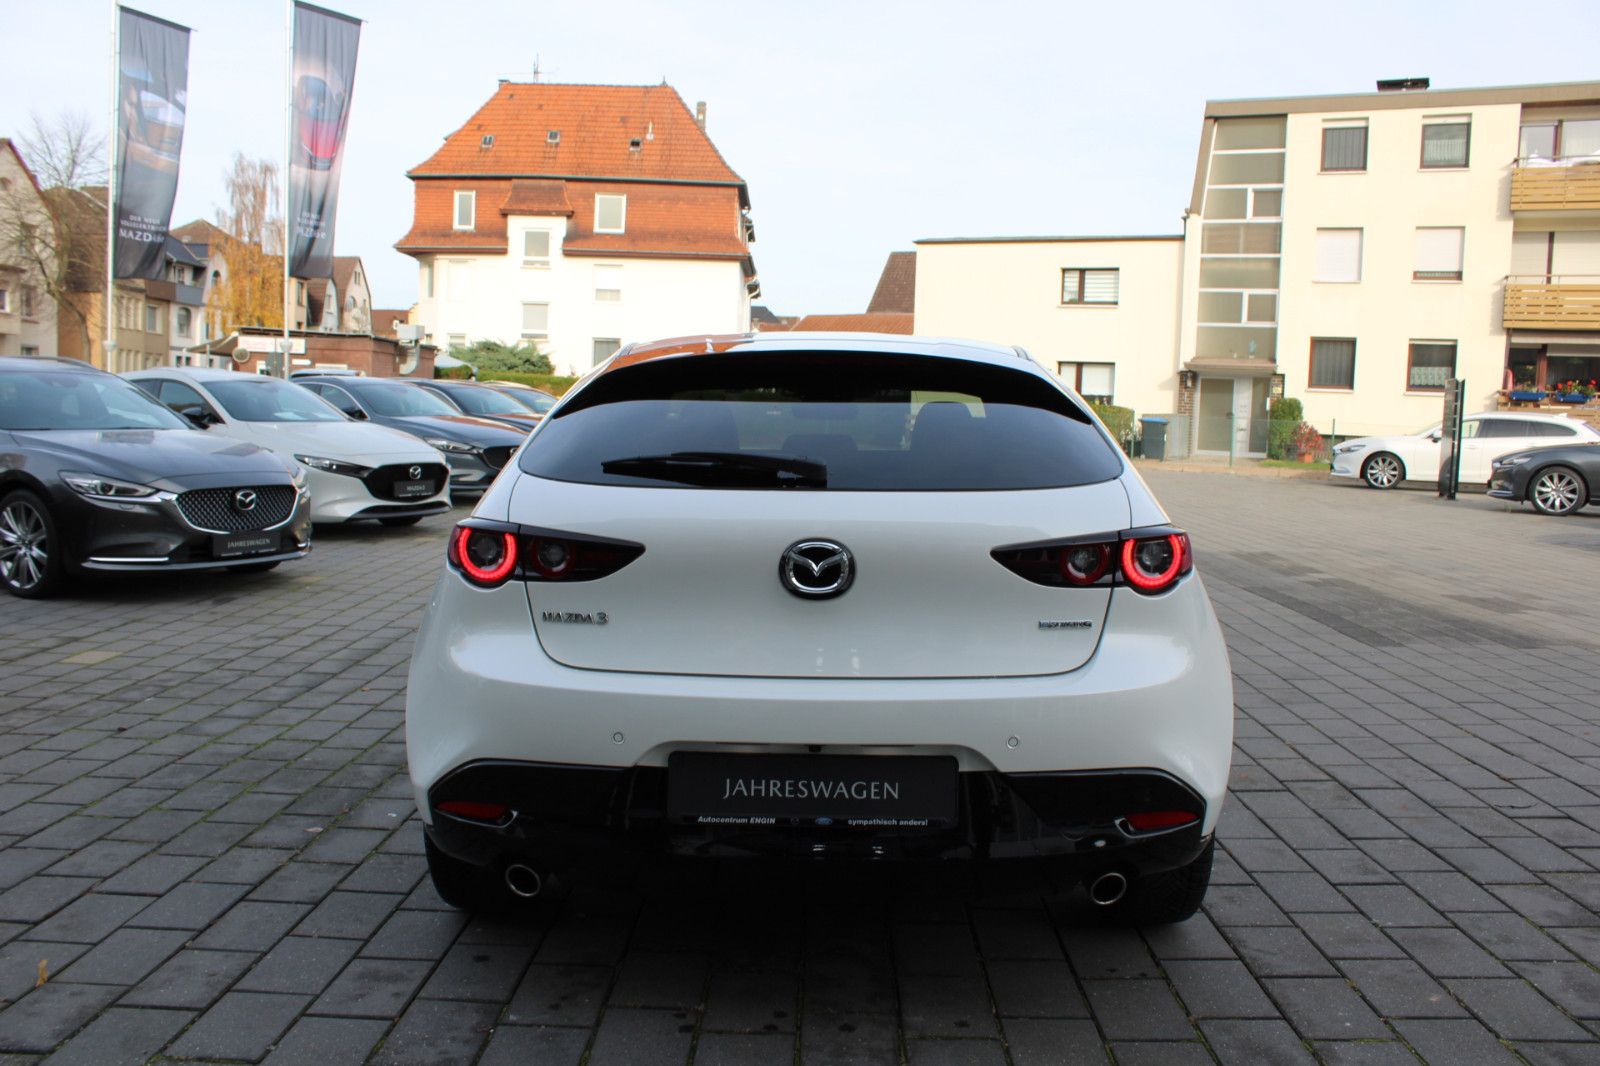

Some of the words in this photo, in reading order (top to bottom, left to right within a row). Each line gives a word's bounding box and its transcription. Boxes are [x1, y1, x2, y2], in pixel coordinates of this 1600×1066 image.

[542, 611, 595, 624] MAZDA
[723, 778, 900, 800] JAHRESWAGEN
[698, 815, 748, 824] Autocentrum
[749, 816, 776, 825] ENGIN
[847, 818, 898, 827] sympathisch
[899, 818, 929, 826] anders!
